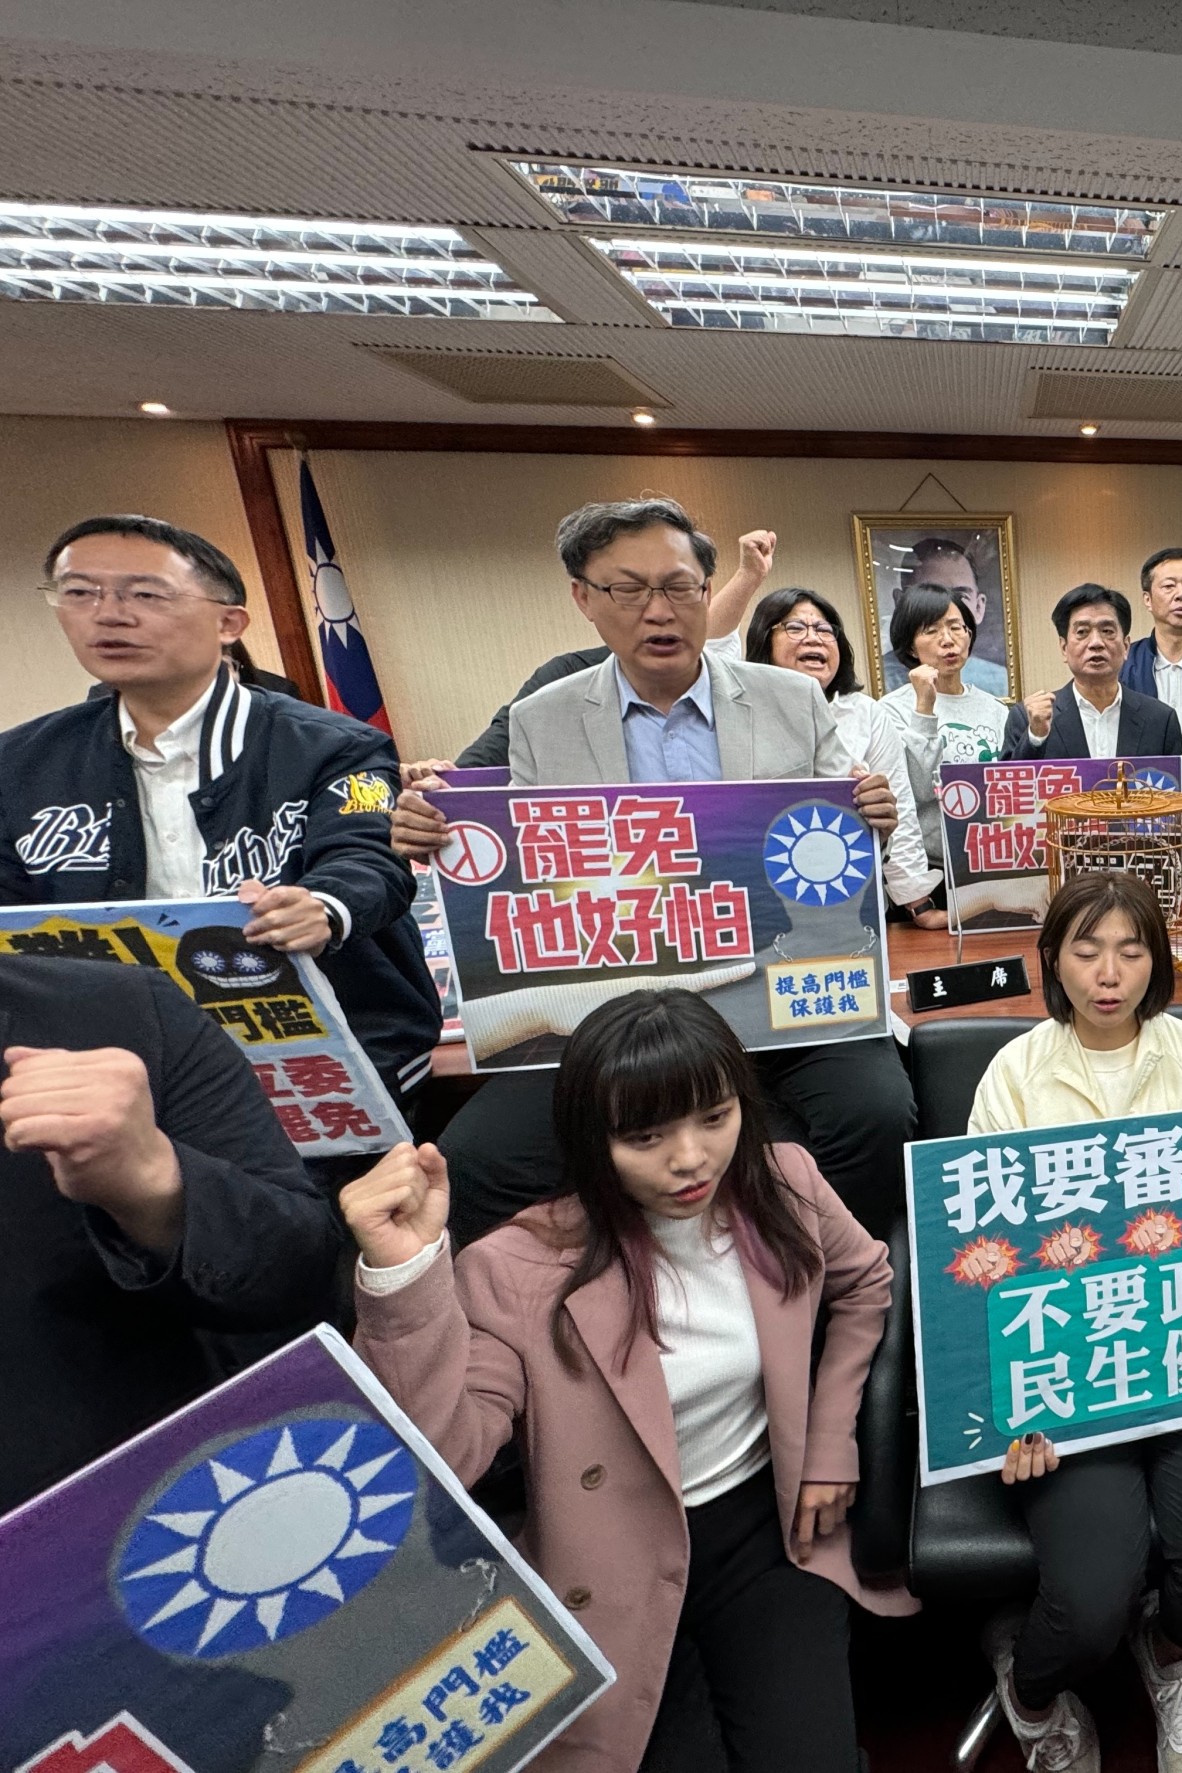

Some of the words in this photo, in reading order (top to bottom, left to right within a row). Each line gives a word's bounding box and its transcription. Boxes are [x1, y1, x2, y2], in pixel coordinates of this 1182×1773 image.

[984, 765, 1083, 818] 罷免
[510, 796, 701, 883] 罷免
[964, 820, 1064, 874] 他好
[485, 881, 755, 974] 他好怕
[775, 969, 871, 996] 提高門檻
[789, 995, 860, 1017] 保護我
[218, 1000, 322, 1042] 門檻
[253, 1054, 356, 1099] 立委
[274, 1101, 382, 1144] 罷免
[405, 1681, 531, 1773] 護我
